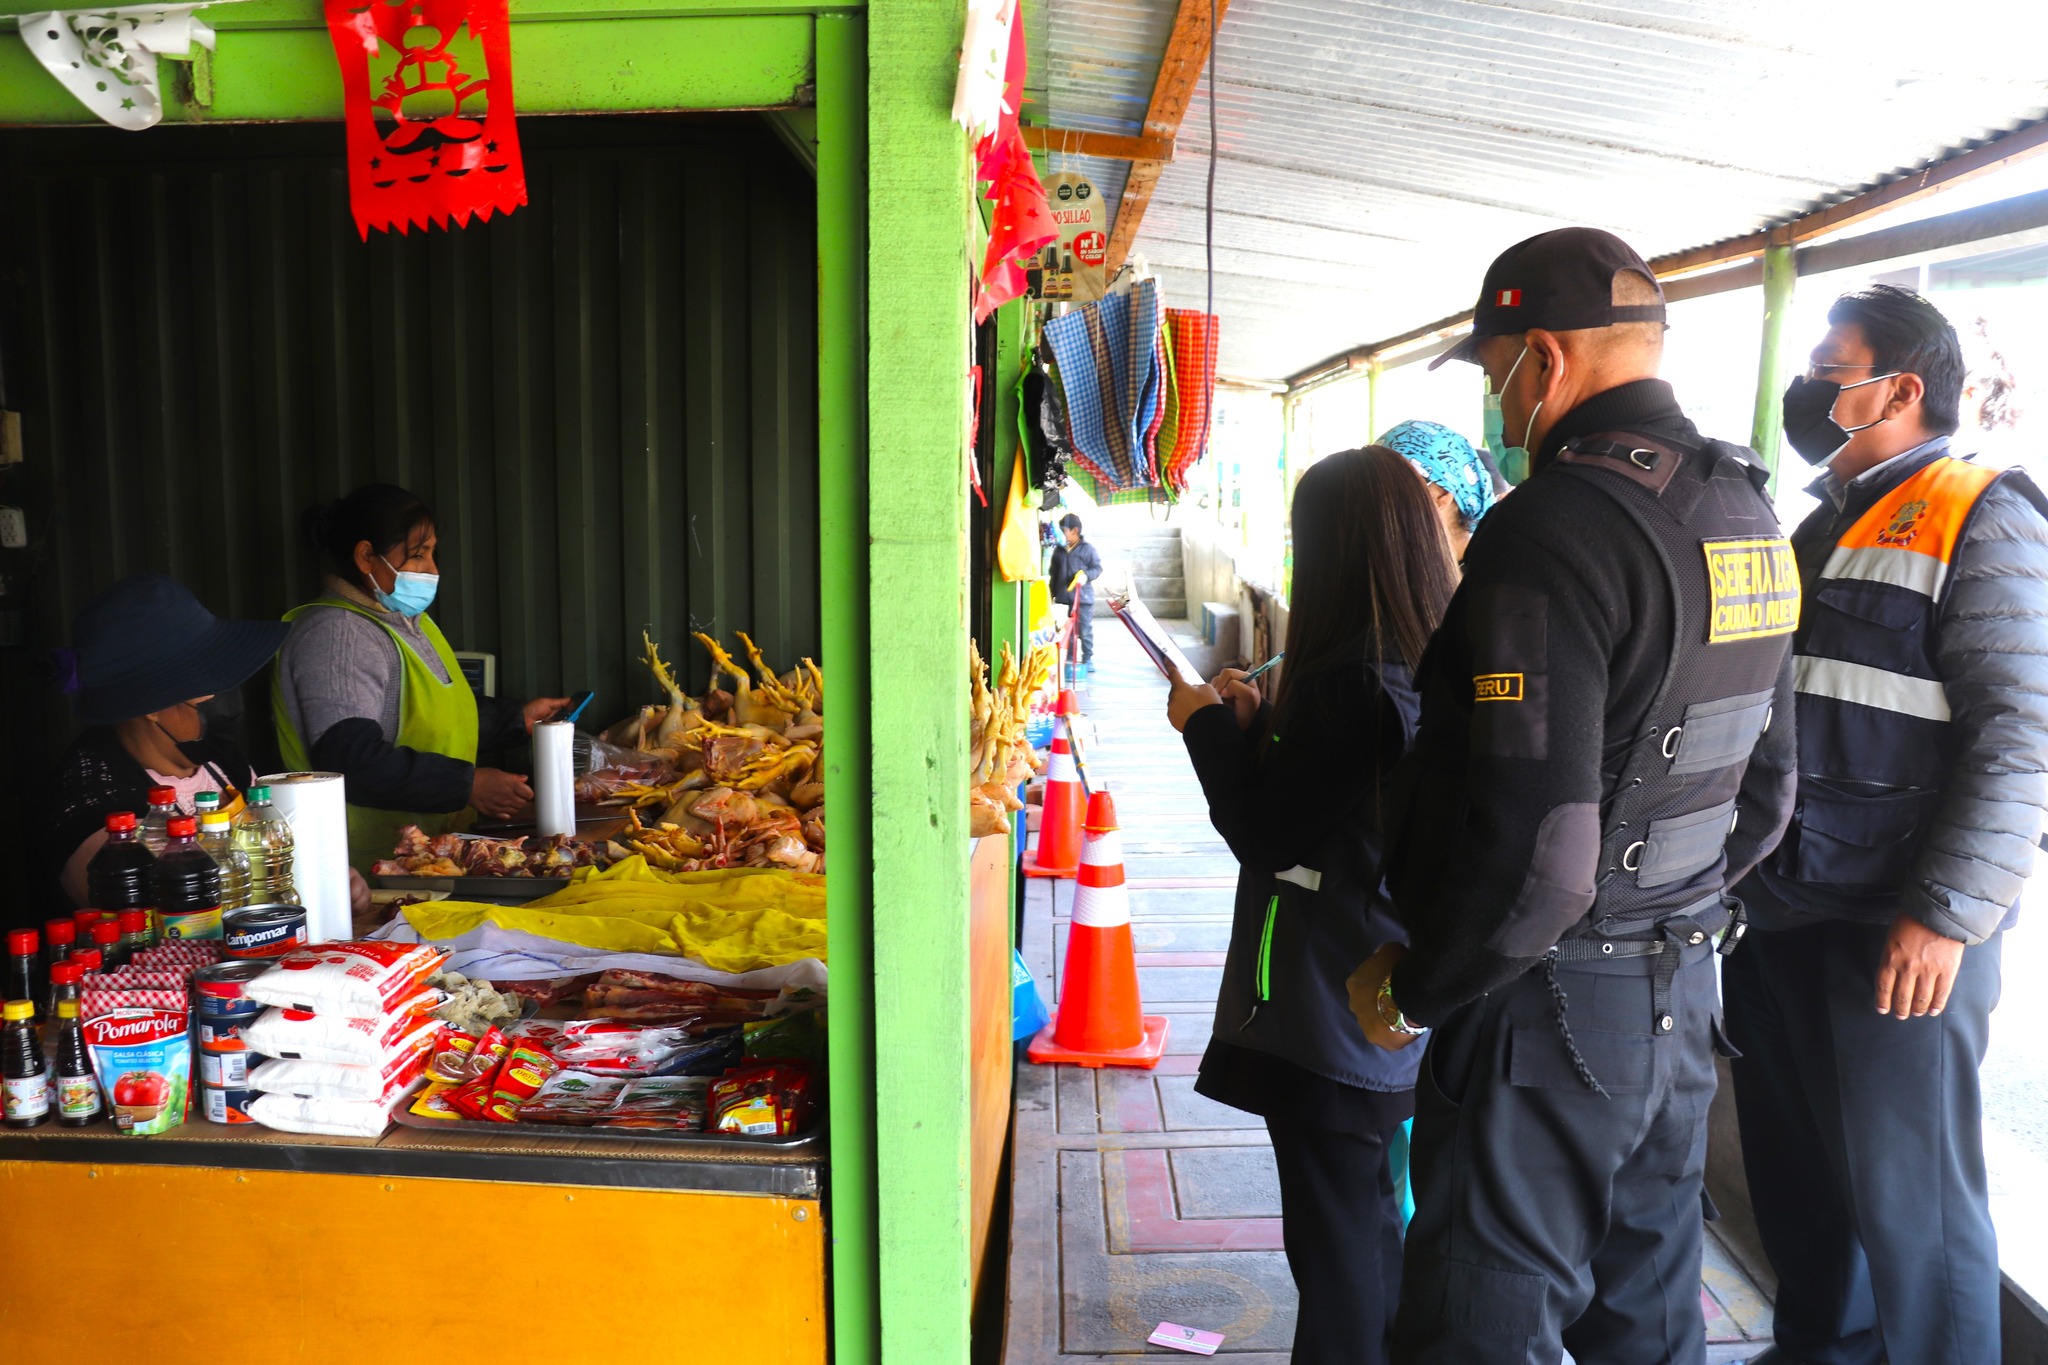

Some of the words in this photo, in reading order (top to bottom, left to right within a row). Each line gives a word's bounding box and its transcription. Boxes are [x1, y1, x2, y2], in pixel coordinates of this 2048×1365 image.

[1715, 602, 1762, 632] CIUDAD
[226, 925, 289, 947] Campomar
[93, 1014, 178, 1042] Pomarola
